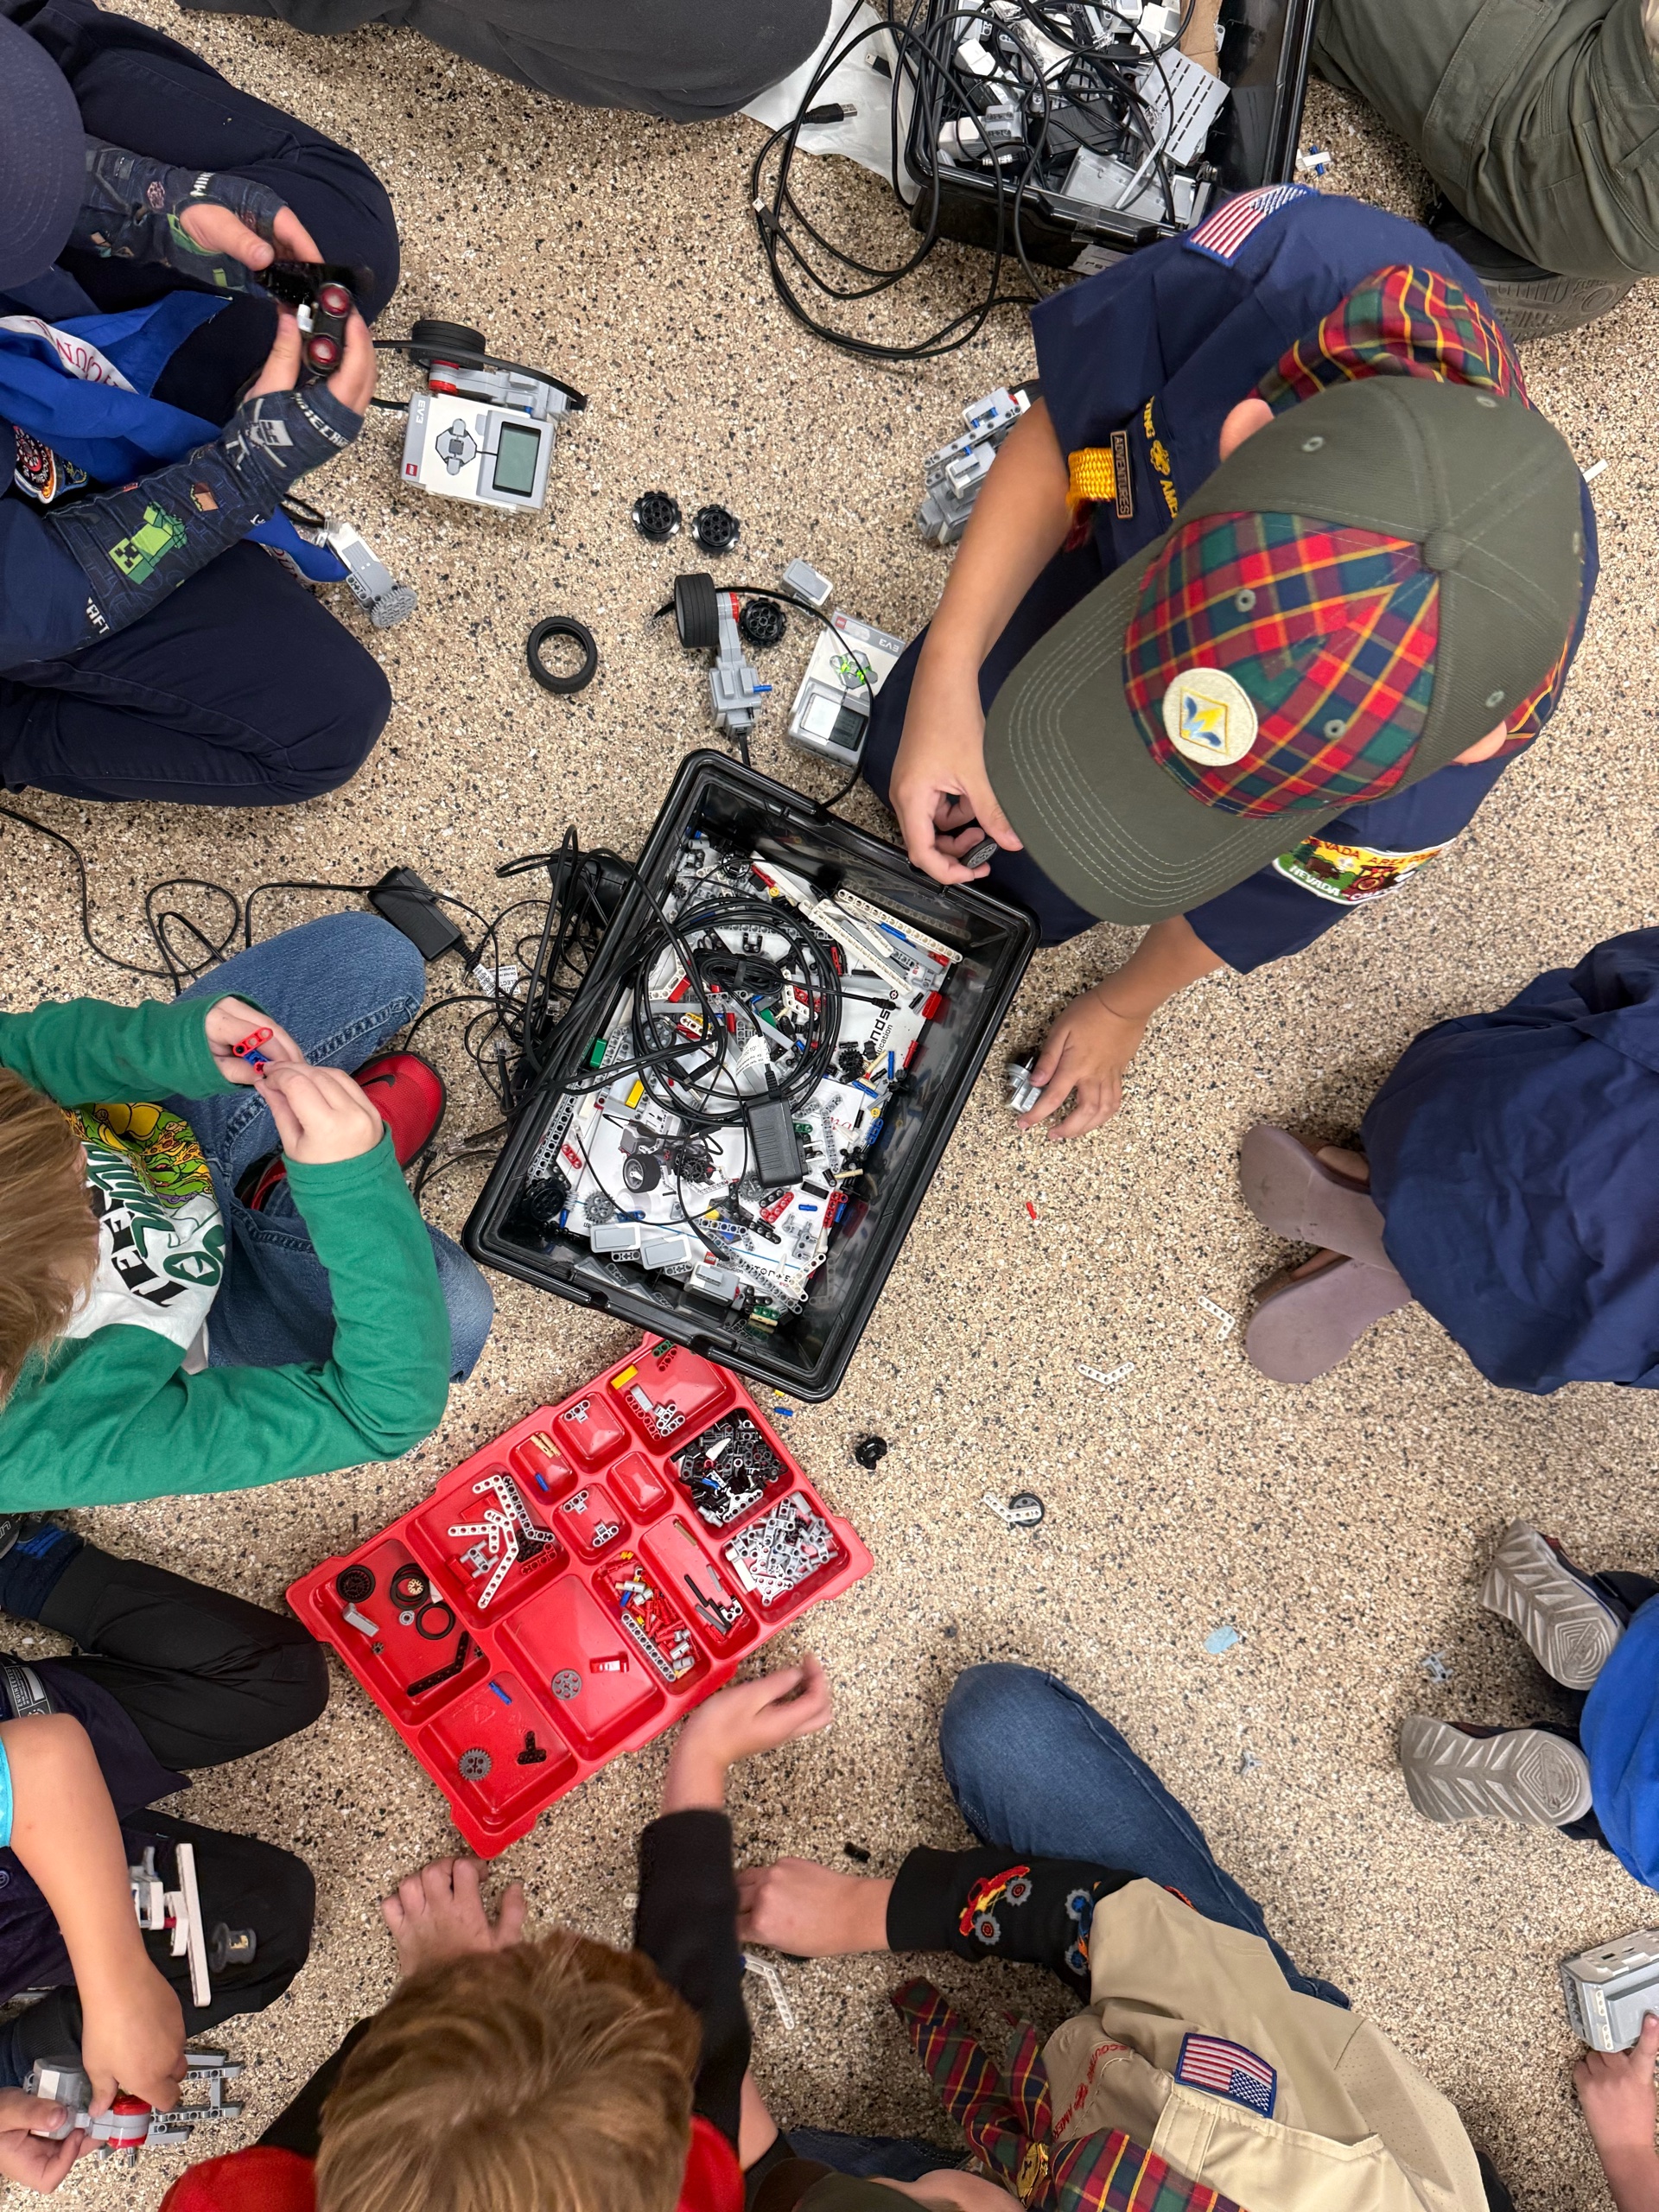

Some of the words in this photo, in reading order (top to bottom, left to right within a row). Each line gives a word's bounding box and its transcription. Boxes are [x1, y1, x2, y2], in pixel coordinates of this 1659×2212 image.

[416, 400, 426, 424] EV3
[1114, 436, 1130, 515] ADVENTURES
[879, 638, 899, 653] EV3
[1288, 865, 1340, 897] NEVADA
[7, 1669, 23, 1707] ENGINEERED
